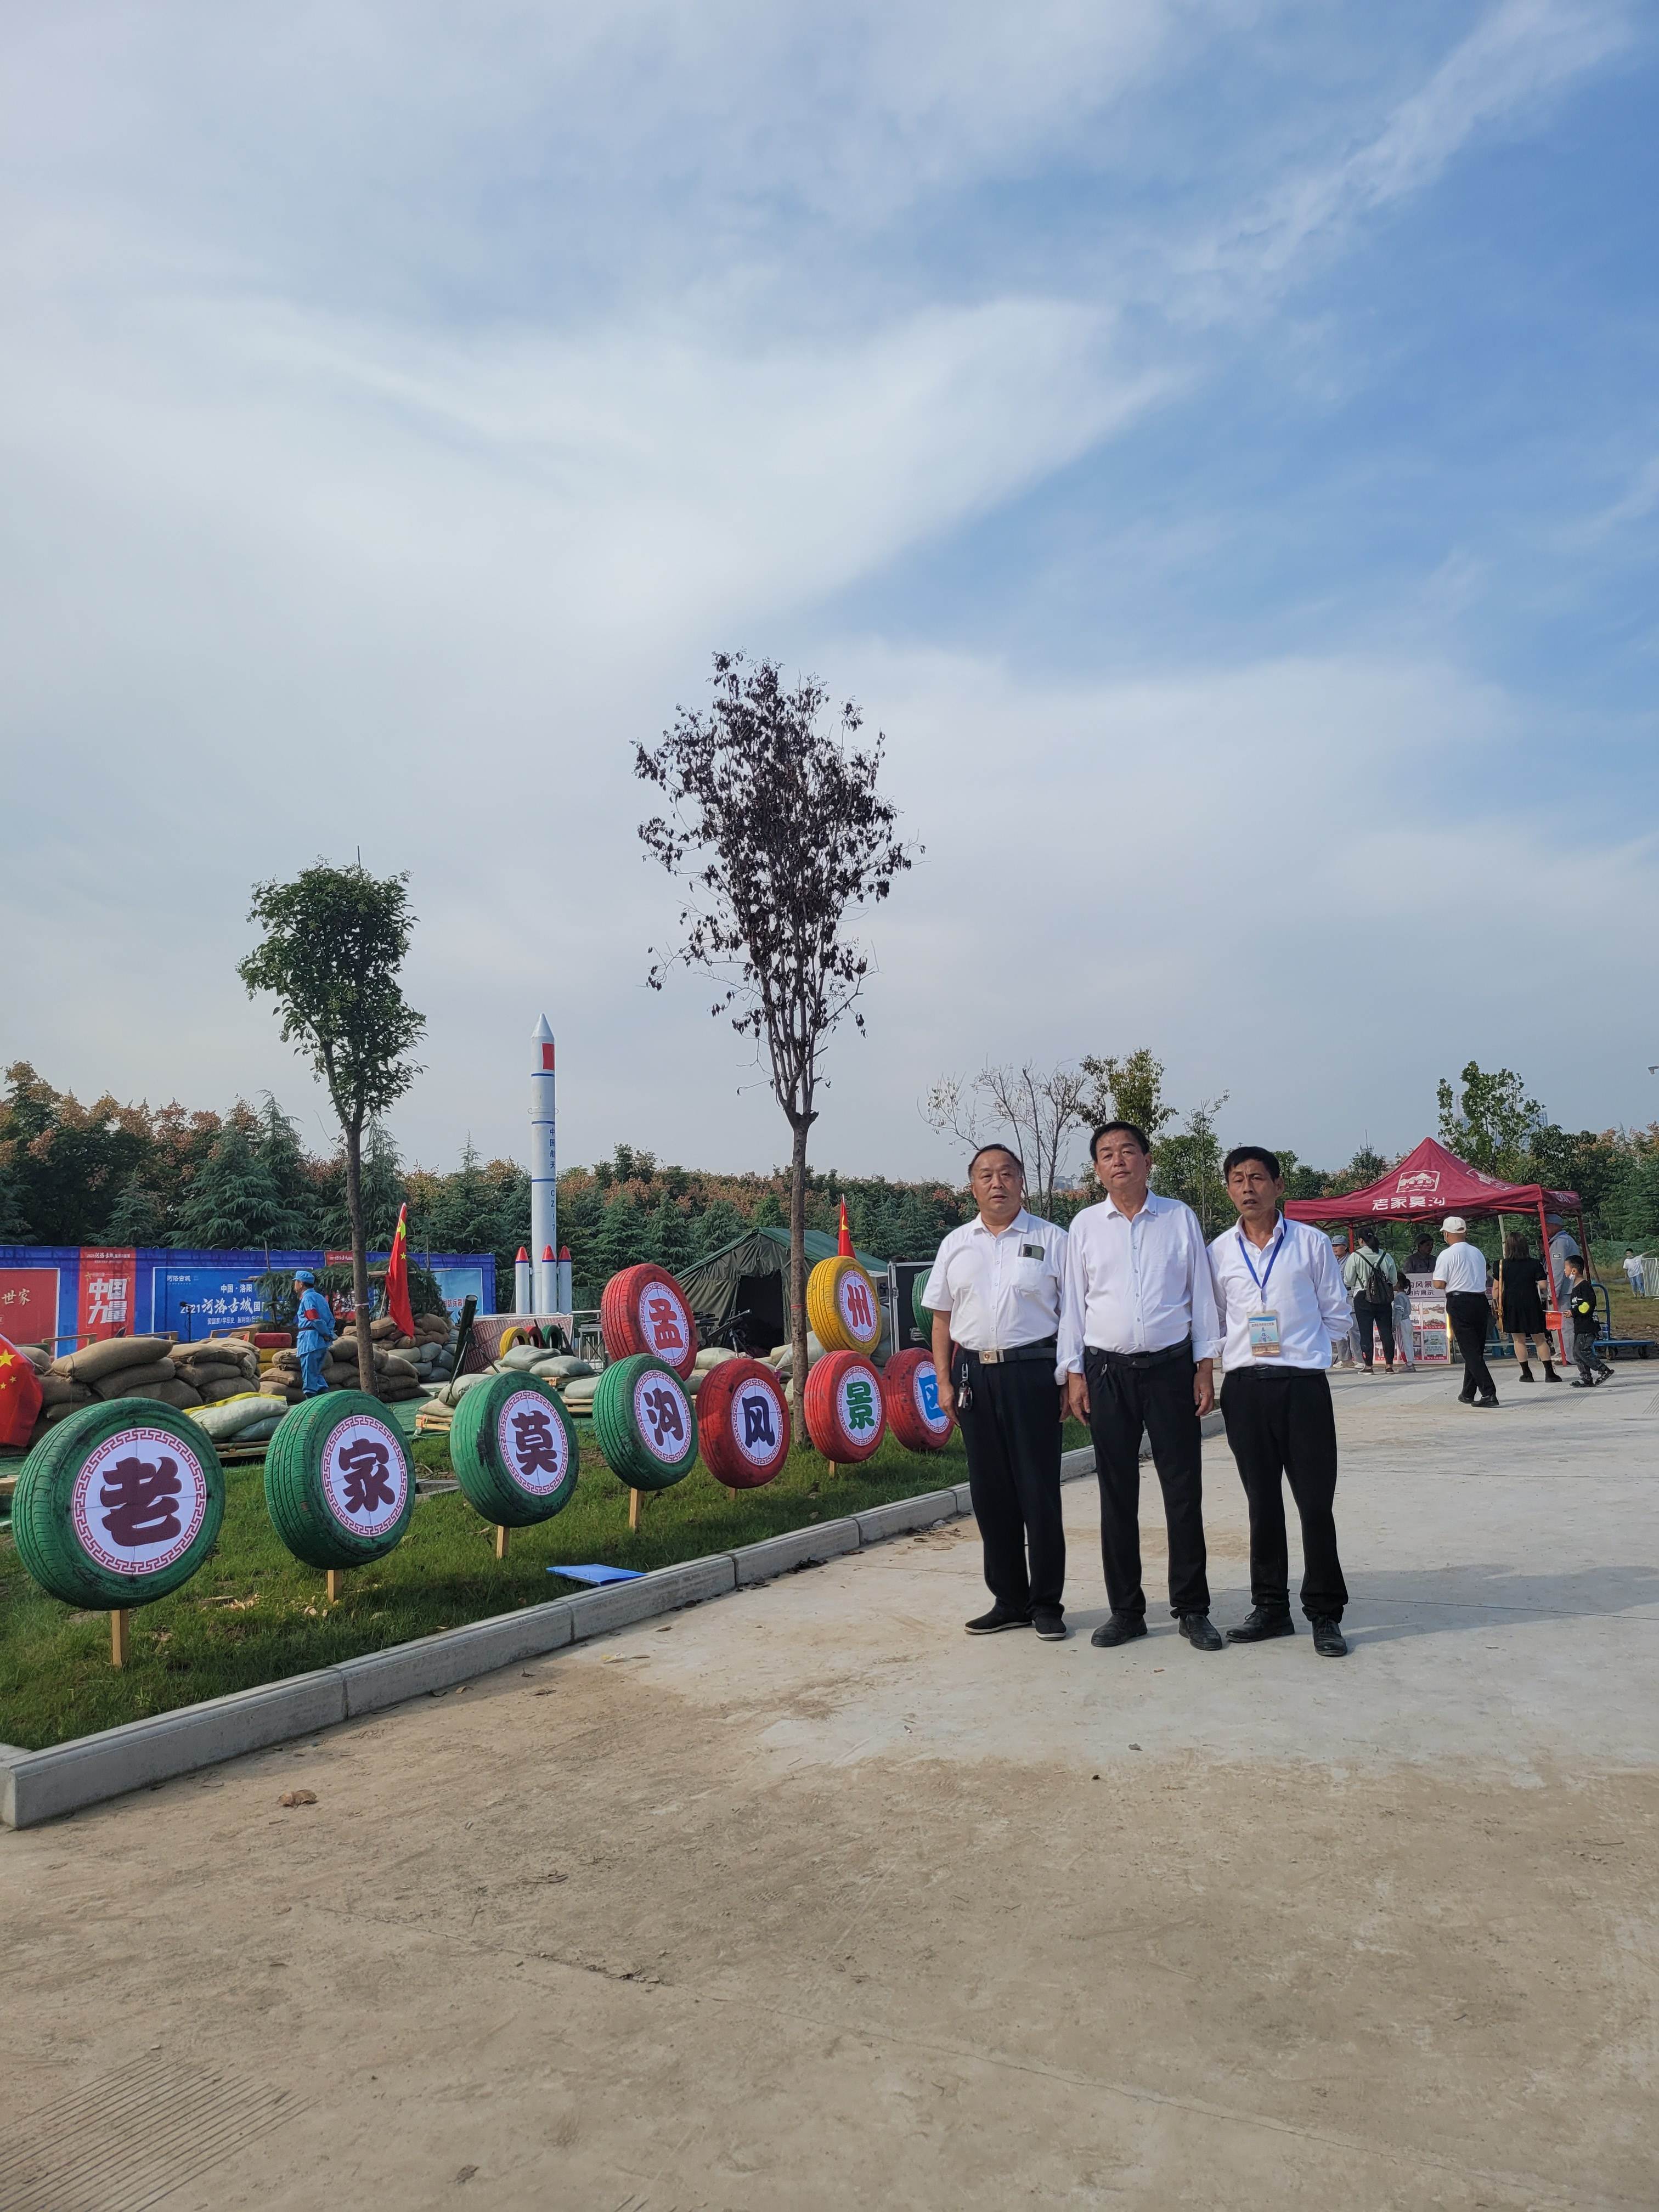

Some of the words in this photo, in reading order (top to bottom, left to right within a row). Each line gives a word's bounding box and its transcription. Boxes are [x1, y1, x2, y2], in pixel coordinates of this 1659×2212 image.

[1372, 1197, 1445, 1211] 老家莫沟
[1, 1288, 31, 1306] 世家
[88, 1278, 127, 1301] 中国
[221, 1284, 252, 1294] 中国·洛阳
[442, 1299, 466, 1307] 国防兵器
[847, 1284, 873, 1328] 州
[88, 1301, 128, 1324] 力量
[648, 1298, 684, 1350] 孟
[642, 1387, 684, 1447] 沟
[742, 1396, 776, 1448] 风
[845, 1381, 875, 1430] 景
[511, 1410, 558, 1476] 莫
[338, 1437, 396, 1514] 家
[99, 1456, 182, 1547] 老
